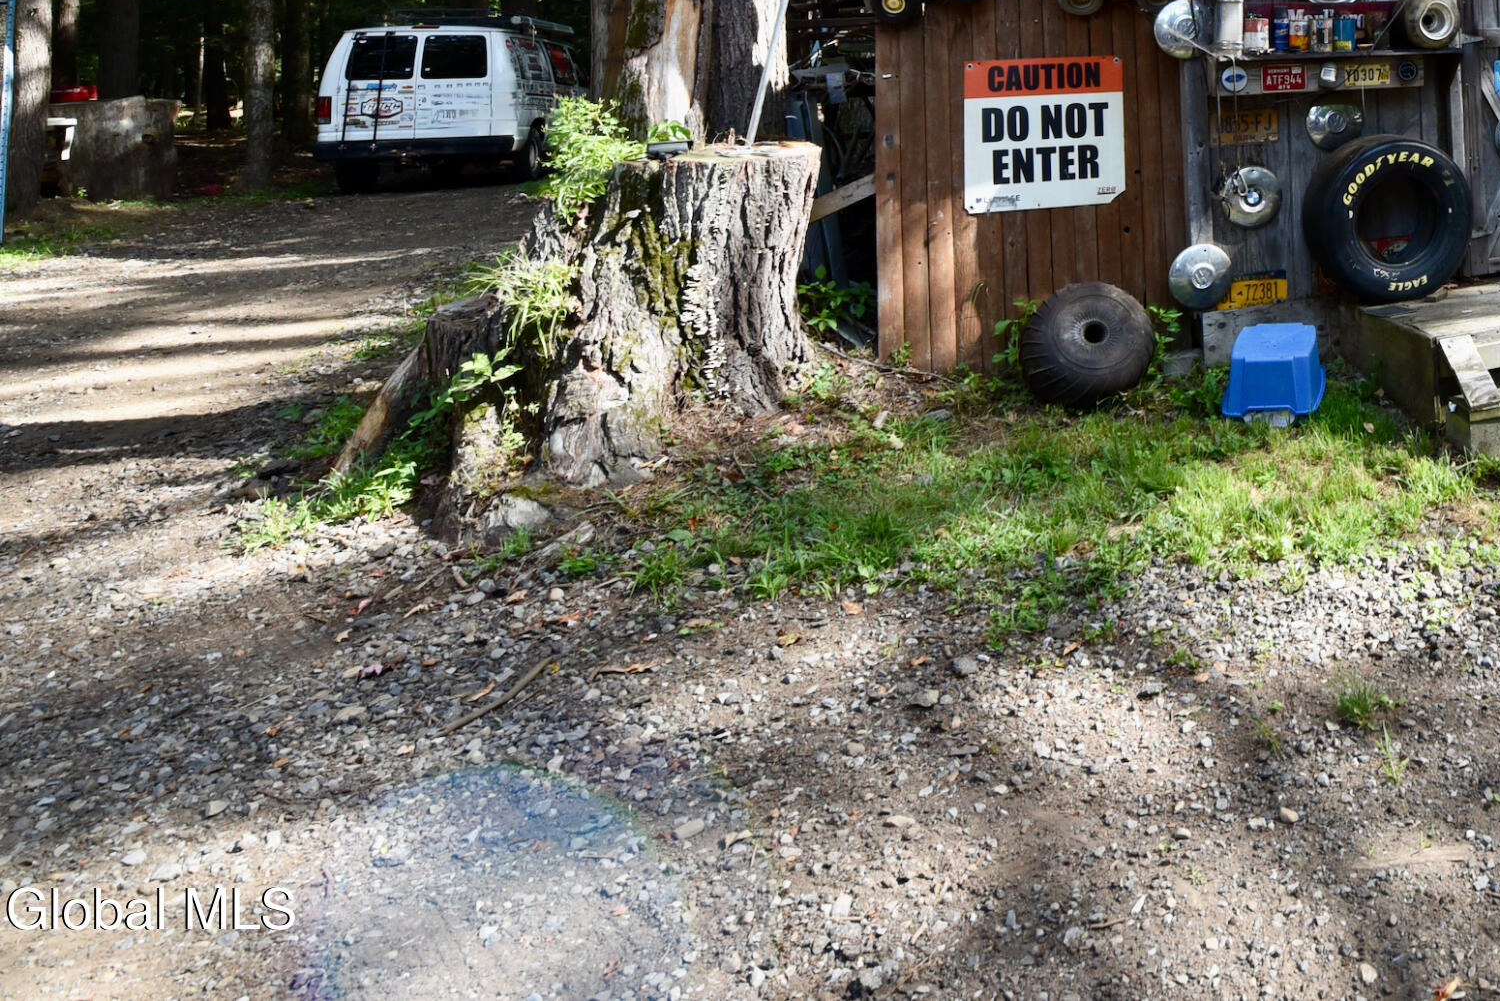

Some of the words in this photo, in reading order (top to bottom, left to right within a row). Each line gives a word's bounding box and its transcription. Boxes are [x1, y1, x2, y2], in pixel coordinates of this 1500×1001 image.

[988, 62, 1101, 92] CAUTION
[1266, 74, 1302, 85] ATF944
[982, 105, 1030, 143] DO
[1040, 102, 1109, 140] NOT
[993, 144, 1100, 185] ENTER
[1342, 151, 1436, 206] GOODYEAR
[1245, 281, 1278, 301] 72381
[1388, 274, 1429, 292] EAGLE
